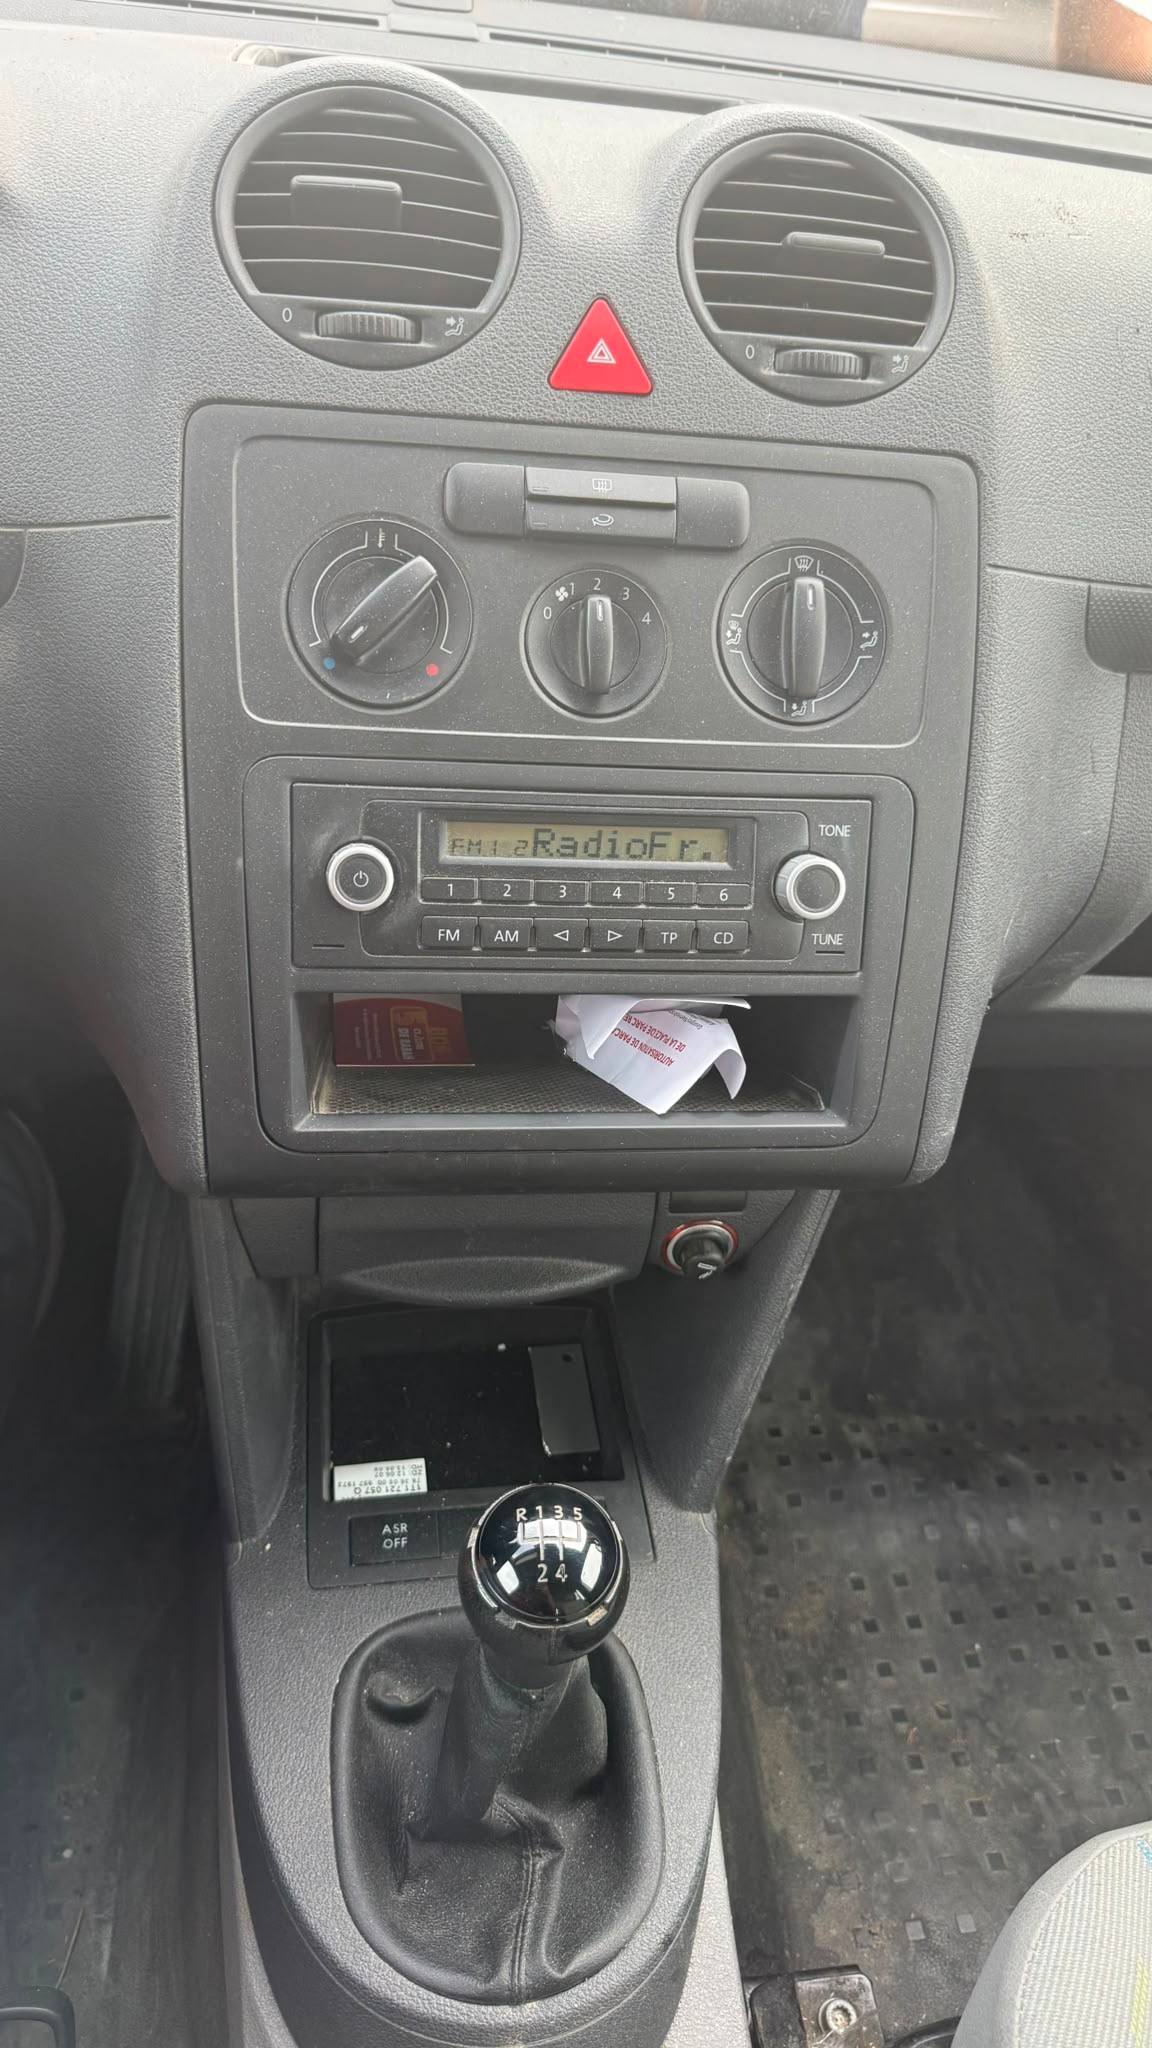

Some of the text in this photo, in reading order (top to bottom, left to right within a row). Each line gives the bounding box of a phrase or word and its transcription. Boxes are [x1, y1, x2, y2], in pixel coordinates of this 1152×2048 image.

[282, 307, 293, 323] 0
[745, 344, 755, 360] 0
[569, 582, 575, 596] 1
[593, 577, 601, 591] 2
[622, 587, 630, 601] 3
[543, 606, 552, 620] 0
[641, 611, 652, 625] 4
[818, 824, 852, 838] TONE
[532, 827, 712, 861] RadioFr.
[447, 883, 453, 897] 1
[503, 884, 512, 898] 2
[559, 885, 567, 899] 3
[612, 886, 622, 900] 4
[667, 887, 675, 900] 5
[719, 888, 729, 902] 6
[438, 928, 460, 942] FM
[493, 929, 519, 943] AM
[660, 931, 678, 945] TP
[713, 931, 734, 945] CD
[811, 933, 844, 946] TUNE
[632, 1017, 648, 1032] PARC
[675, 1042, 686, 1052] DE
[638, 1042, 674, 1067] AUTORISATION
[353, 1487, 362, 1495] Q
[385, 1485, 401, 1493] 721
[516, 1505, 583, 1522] R 1 3 5
[381, 1522, 408, 1535] ASR
[383, 1536, 408, 1549] OFF
[537, 1563, 568, 1583] 2 4
